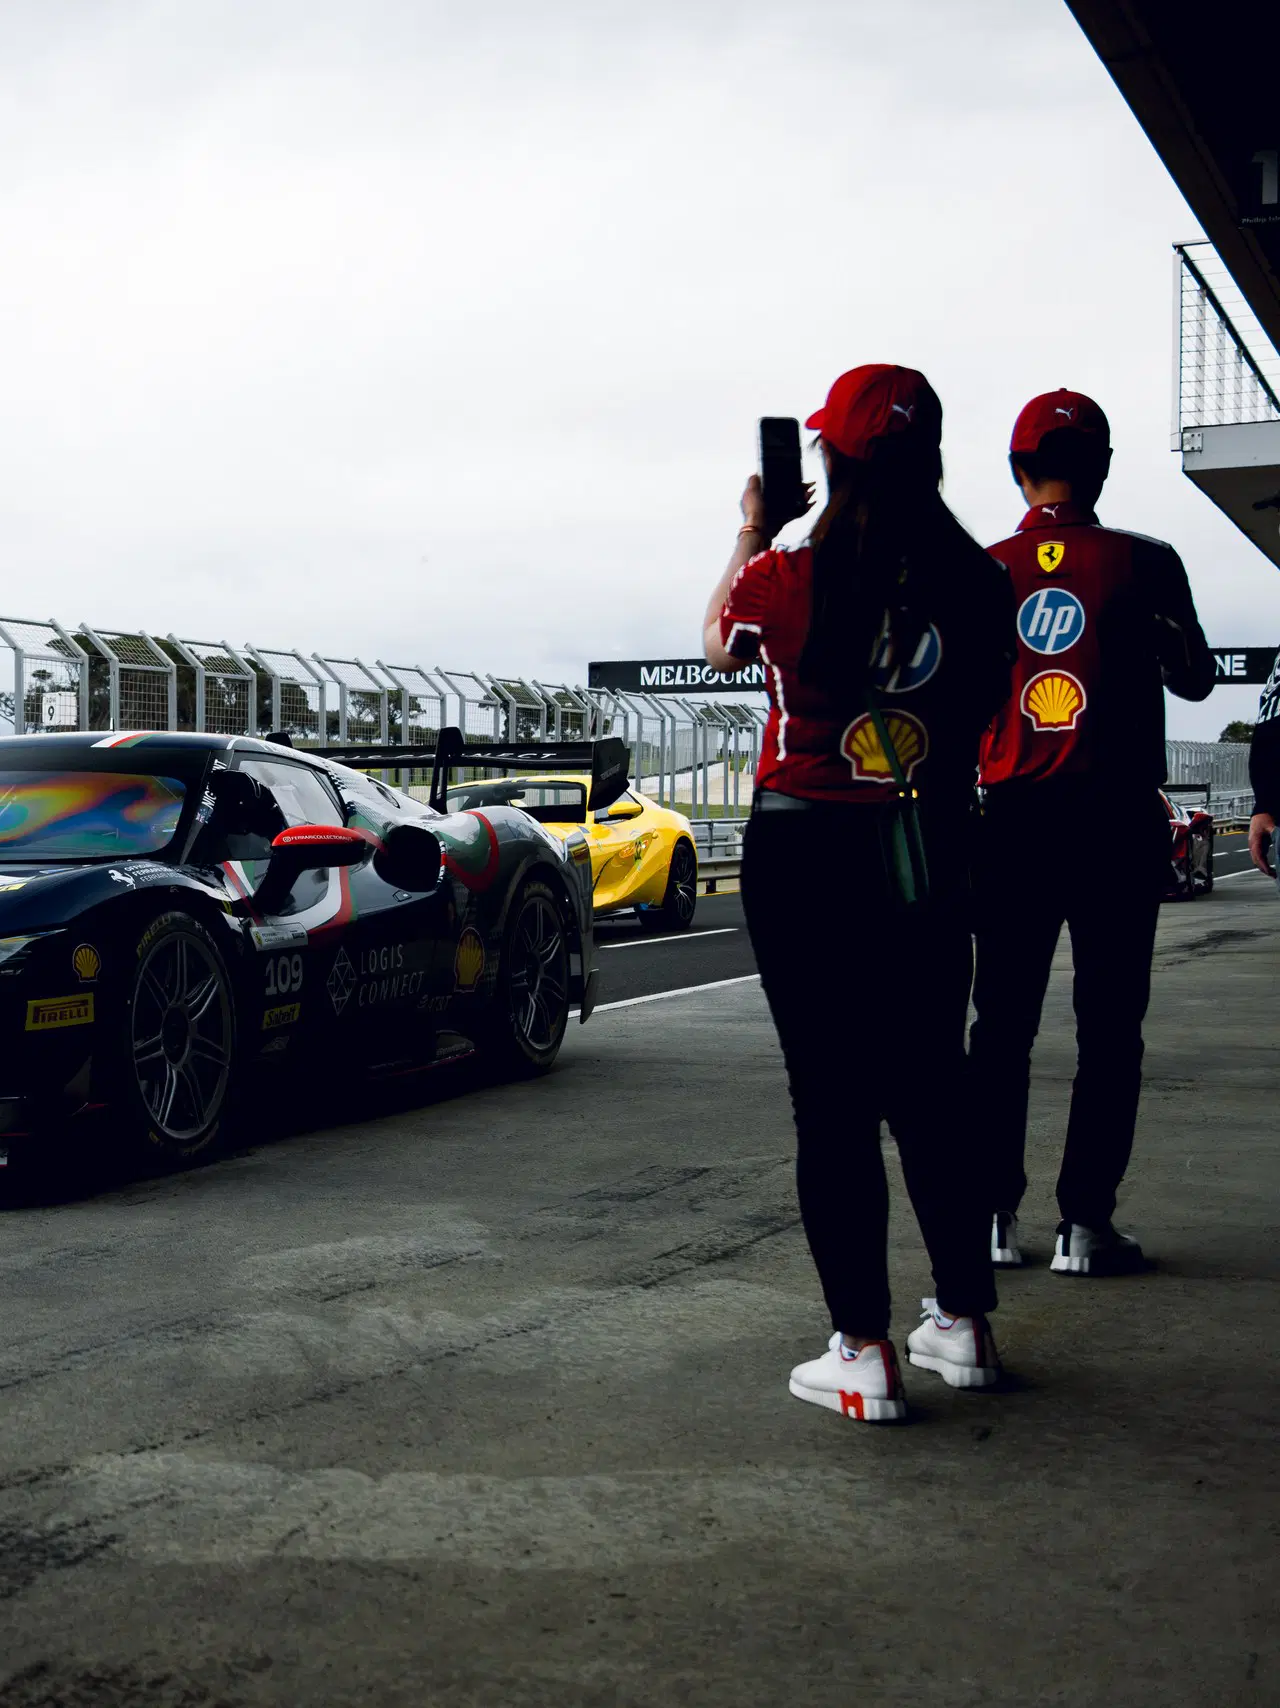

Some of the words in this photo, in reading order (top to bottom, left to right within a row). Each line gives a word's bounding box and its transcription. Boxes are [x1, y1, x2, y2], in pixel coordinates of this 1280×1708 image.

[1027, 591, 1076, 653] hp
[640, 664, 767, 686] MELBOURN
[47, 705, 55, 721] 9
[264, 954, 303, 996] 109
[361, 943, 404, 975] LOGIS
[358, 971, 425, 1007] CONNECT
[32, 999, 89, 1024] PIRELLI
